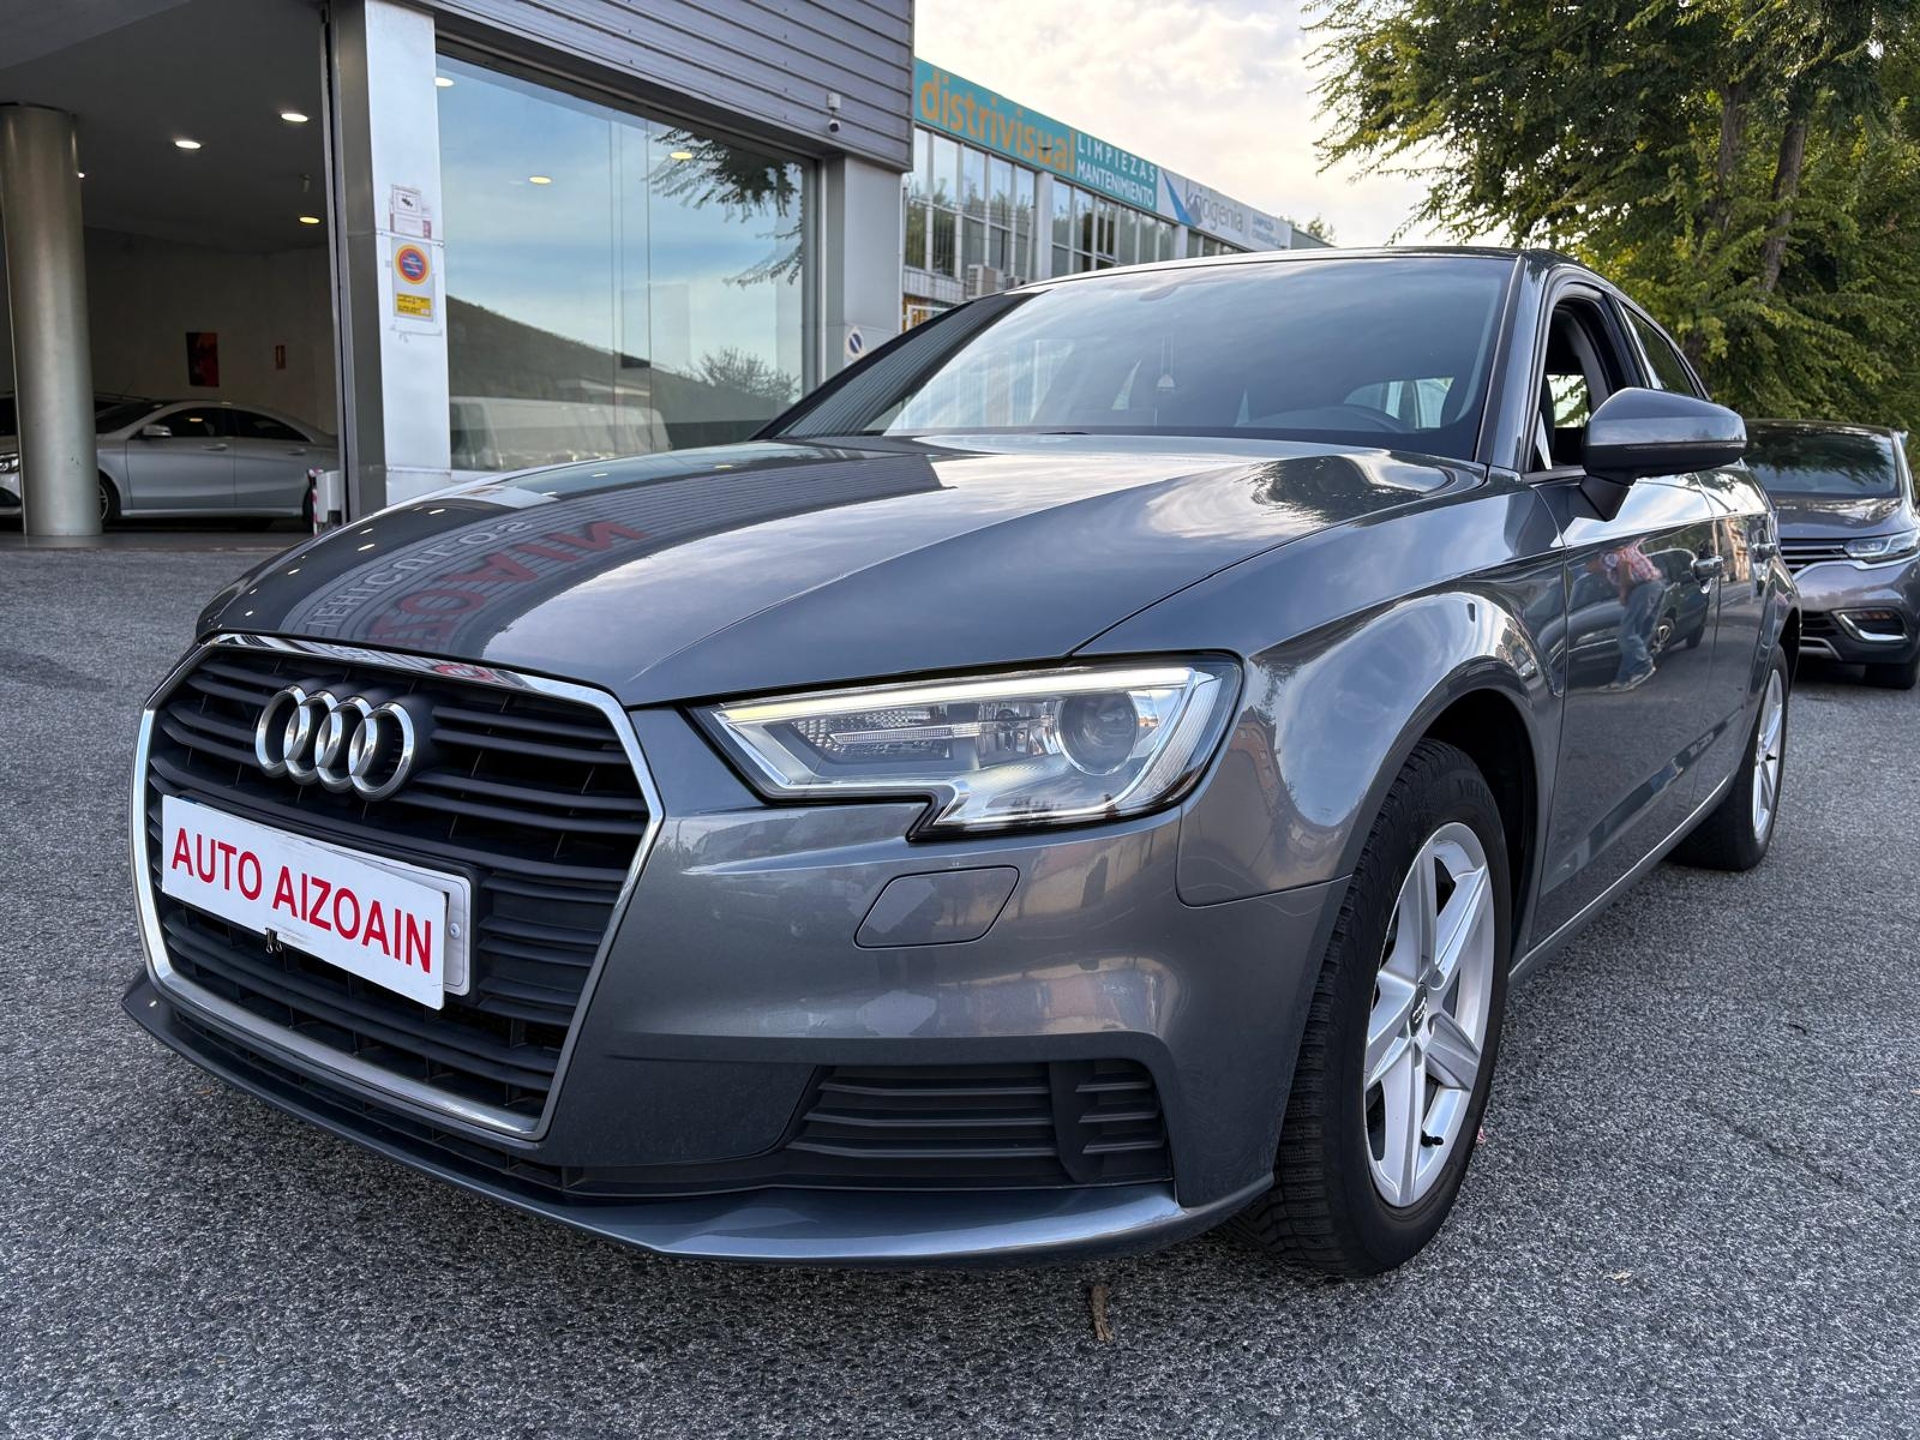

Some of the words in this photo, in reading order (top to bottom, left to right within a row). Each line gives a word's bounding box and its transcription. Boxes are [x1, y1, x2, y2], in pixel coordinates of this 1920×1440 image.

[921, 72, 1076, 174] distrivisual
[1077, 133, 1156, 183] LIMPIEZAS
[1077, 159, 1154, 207] MANTENIMIENTO
[171, 827, 262, 901] AUTO
[272, 865, 431, 973] AIZOAIN
